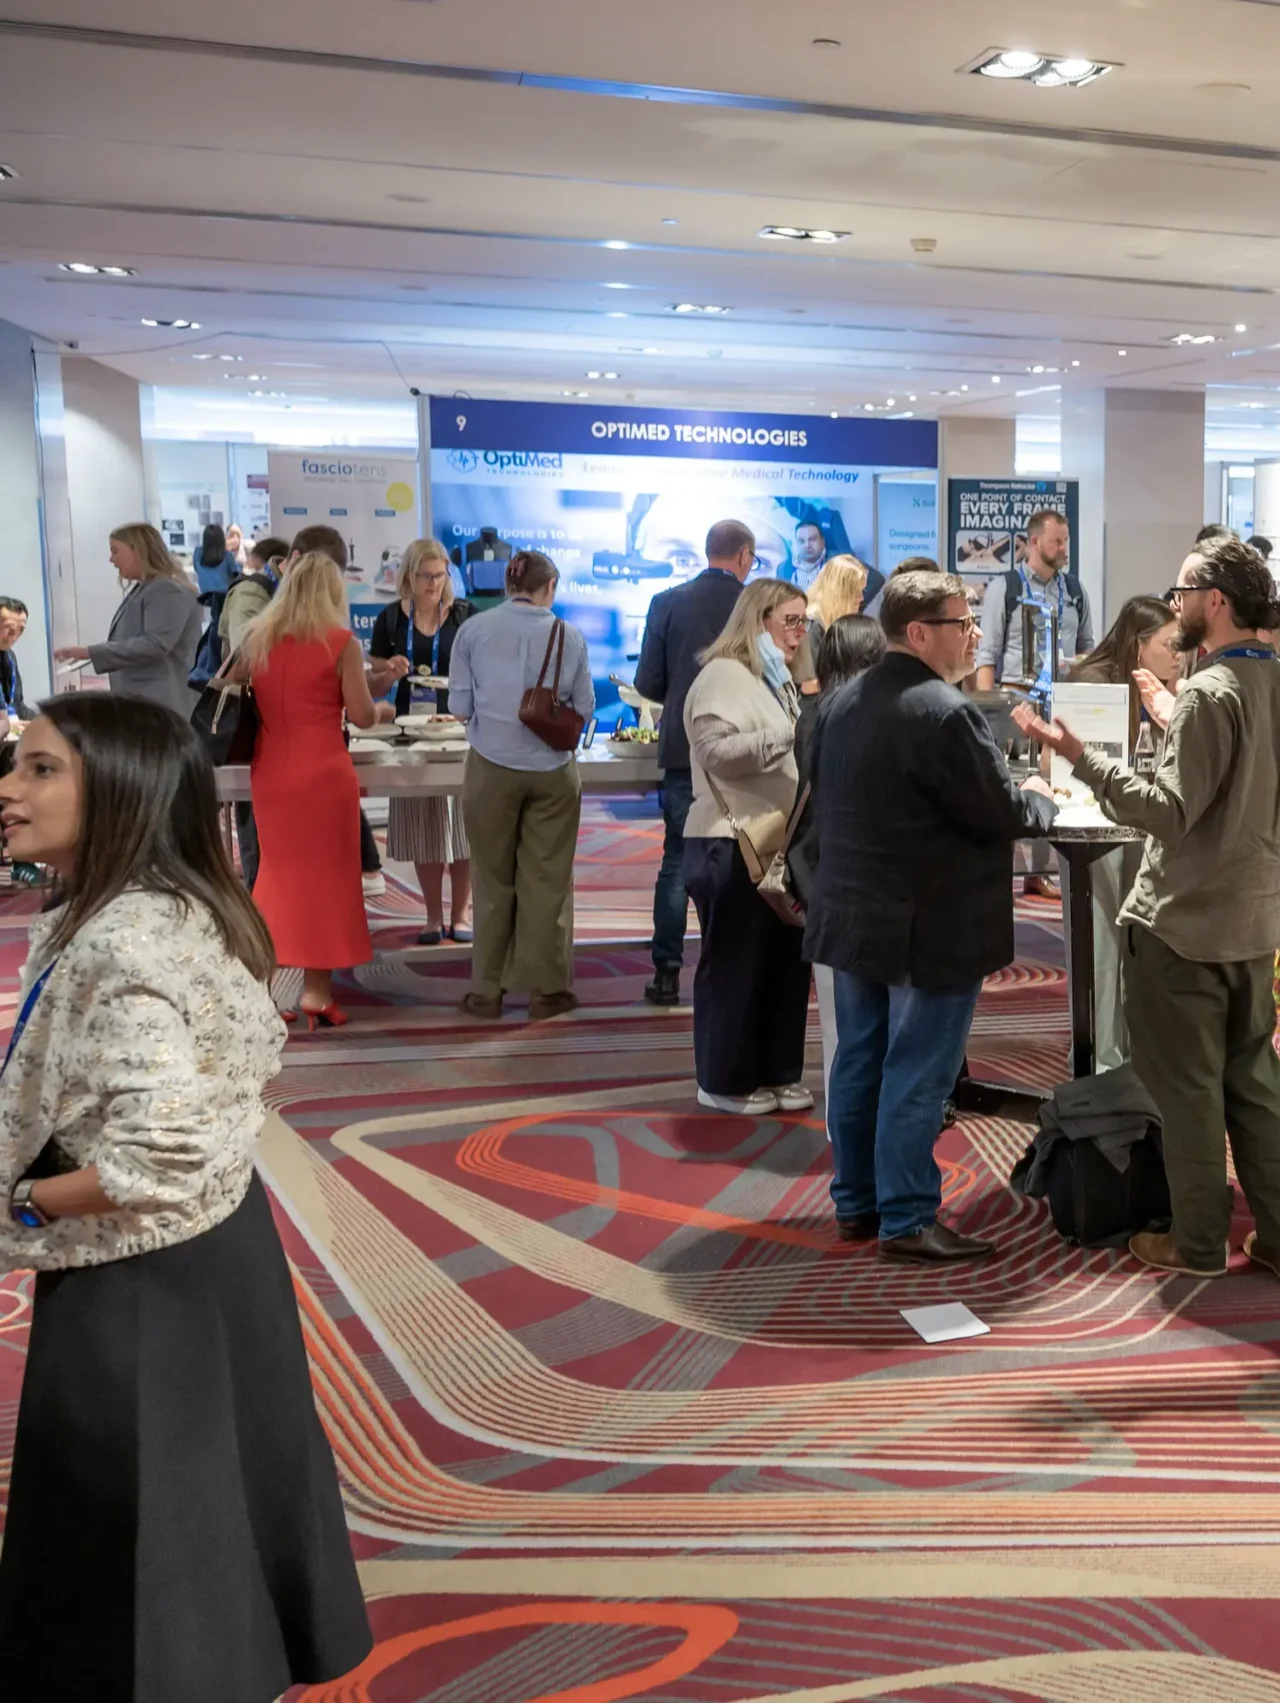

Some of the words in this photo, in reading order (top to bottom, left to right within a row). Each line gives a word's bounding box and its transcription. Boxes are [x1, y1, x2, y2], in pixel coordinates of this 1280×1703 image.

[456, 415, 467, 432] 9
[591, 421, 671, 442] OPTIMED
[674, 424, 808, 447] TECHNOLOGIES
[731, 467, 784, 481] Medical
[788, 468, 860, 484] Technology
[960, 493, 979, 501] ONE
[981, 493, 1008, 502] POINT
[1010, 494, 1022, 502] OF
[1024, 494, 1067, 504] CONTACT
[960, 501, 1010, 515] EVERY
[452, 525, 477, 537] Our
[537, 526, 548, 540] is
[551, 528, 565, 540] to
